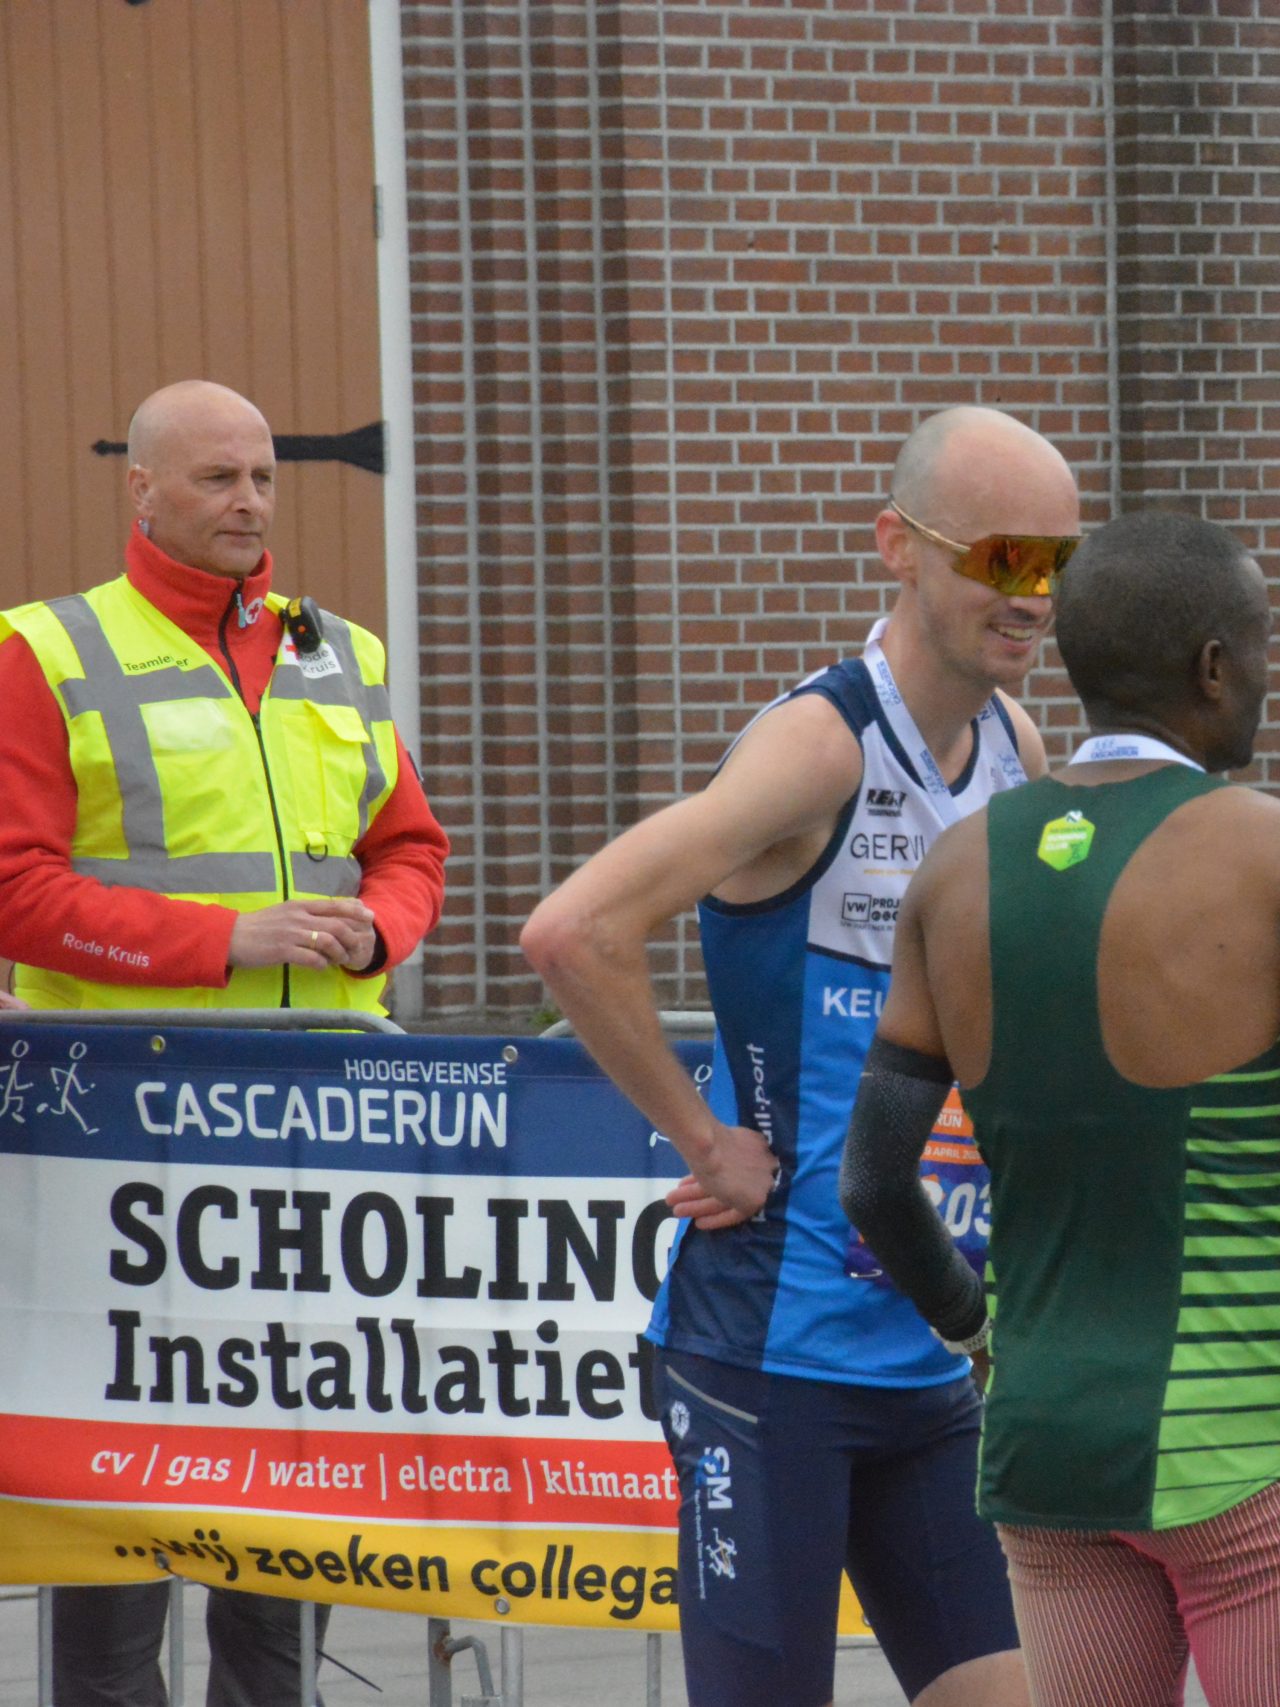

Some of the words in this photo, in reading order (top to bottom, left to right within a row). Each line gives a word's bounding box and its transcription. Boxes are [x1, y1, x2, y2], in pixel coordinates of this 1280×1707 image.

[62, 932, 104, 956] Rode
[107, 944, 151, 968] Kruis
[344, 1059, 508, 1086] HOOGEVEENSE
[135, 1081, 508, 1149] CASCADERUN
[90, 1450, 134, 1475] cv
[165, 1455, 231, 1487] gas
[268, 1456, 366, 1489] water
[399, 1456, 511, 1492] electra
[540, 1460, 680, 1501] klimaat
[245, 1535, 450, 1593] zoeken
